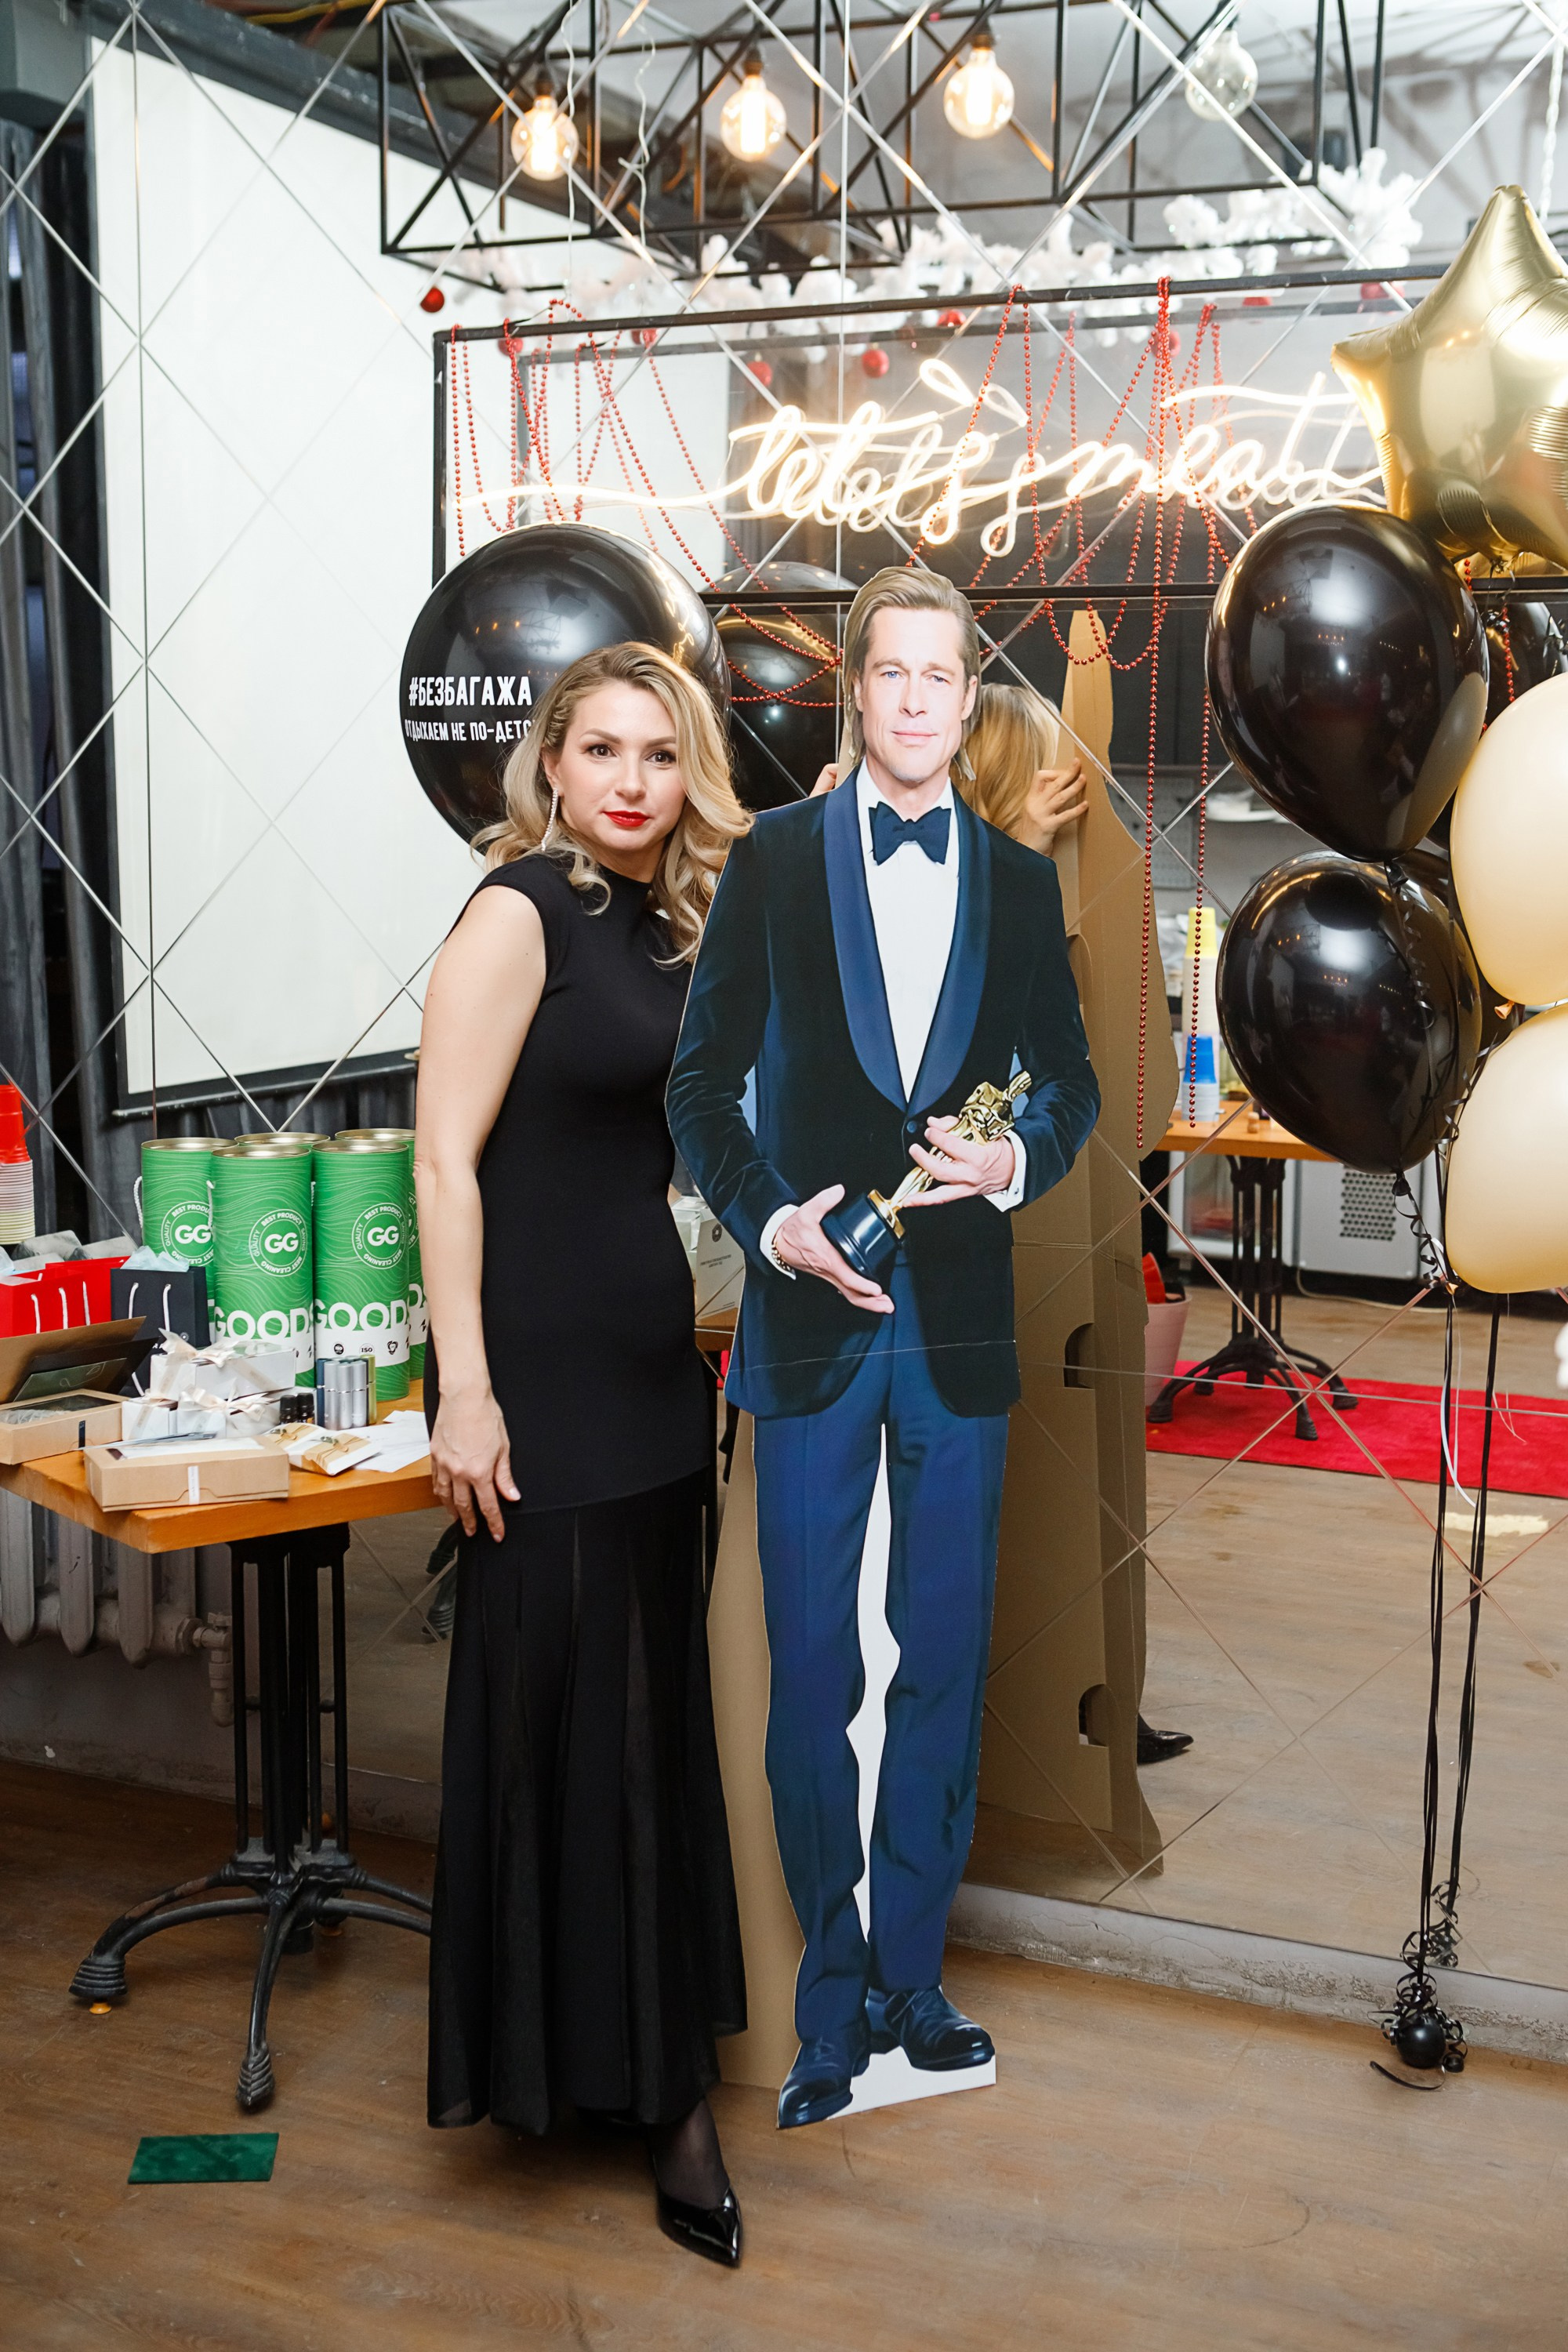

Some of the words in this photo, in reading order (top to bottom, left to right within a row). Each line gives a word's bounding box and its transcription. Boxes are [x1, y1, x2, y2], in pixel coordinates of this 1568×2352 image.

[408, 676, 532, 706] #БЕЗБАГАЖА
[405, 719, 449, 742] ОТДЫХАЕМ
[451, 722, 467, 741] НЕ
[469, 719, 533, 743] ПО-ДЕТС
[261, 1214, 277, 1227] BEST
[277, 1212, 303, 1225] PRODUCT
[364, 1207, 379, 1220] BEST
[379, 1206, 402, 1218] PRODUCT
[175, 1225, 212, 1244] GG
[252, 1229, 260, 1257] QUALITY
[264, 1232, 299, 1254] GG
[367, 1225, 399, 1247] GG
[292, 1256, 303, 1270] BEST
[363, 1253, 393, 1266] CLEANING
[393, 1249, 402, 1262] BEST
[260, 1260, 292, 1274] CLEANING
[314, 1298, 409, 1333] GOOD
